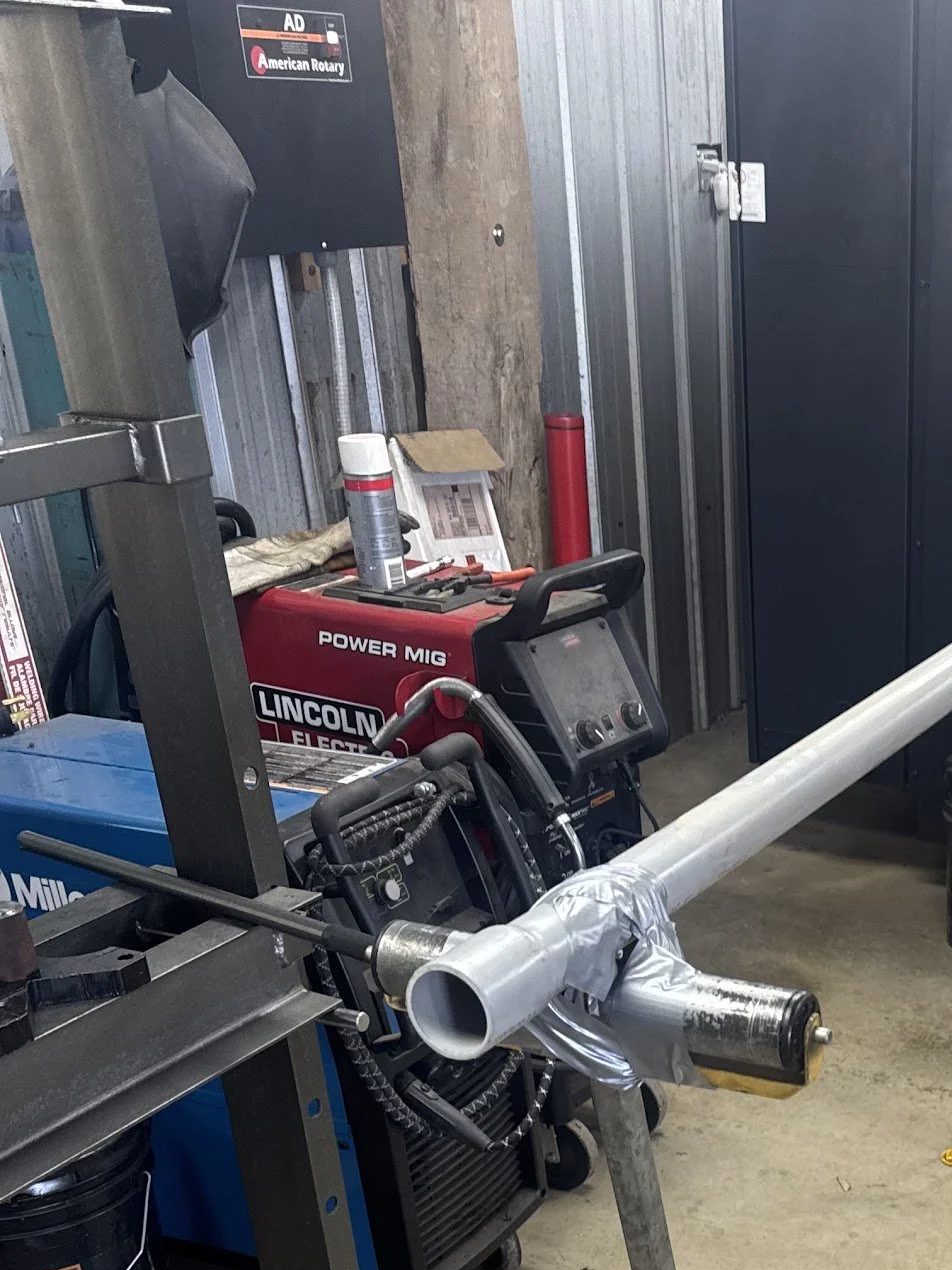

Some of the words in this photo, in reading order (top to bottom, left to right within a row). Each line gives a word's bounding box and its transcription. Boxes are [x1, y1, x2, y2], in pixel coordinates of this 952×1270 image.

[283, 13, 306, 32] AD
[257, 53, 310, 72] American
[310, 58, 345, 77] Rotary
[318, 630, 397, 658] POWER
[404, 646, 447, 667] MIG
[12, 681, 22, 694] DE
[16, 663, 33, 707] ALAMBRE
[24, 660, 39, 701] WELDING
[34, 701, 46, 724] WIRE
[258, 690, 378, 738] LINCOLN
